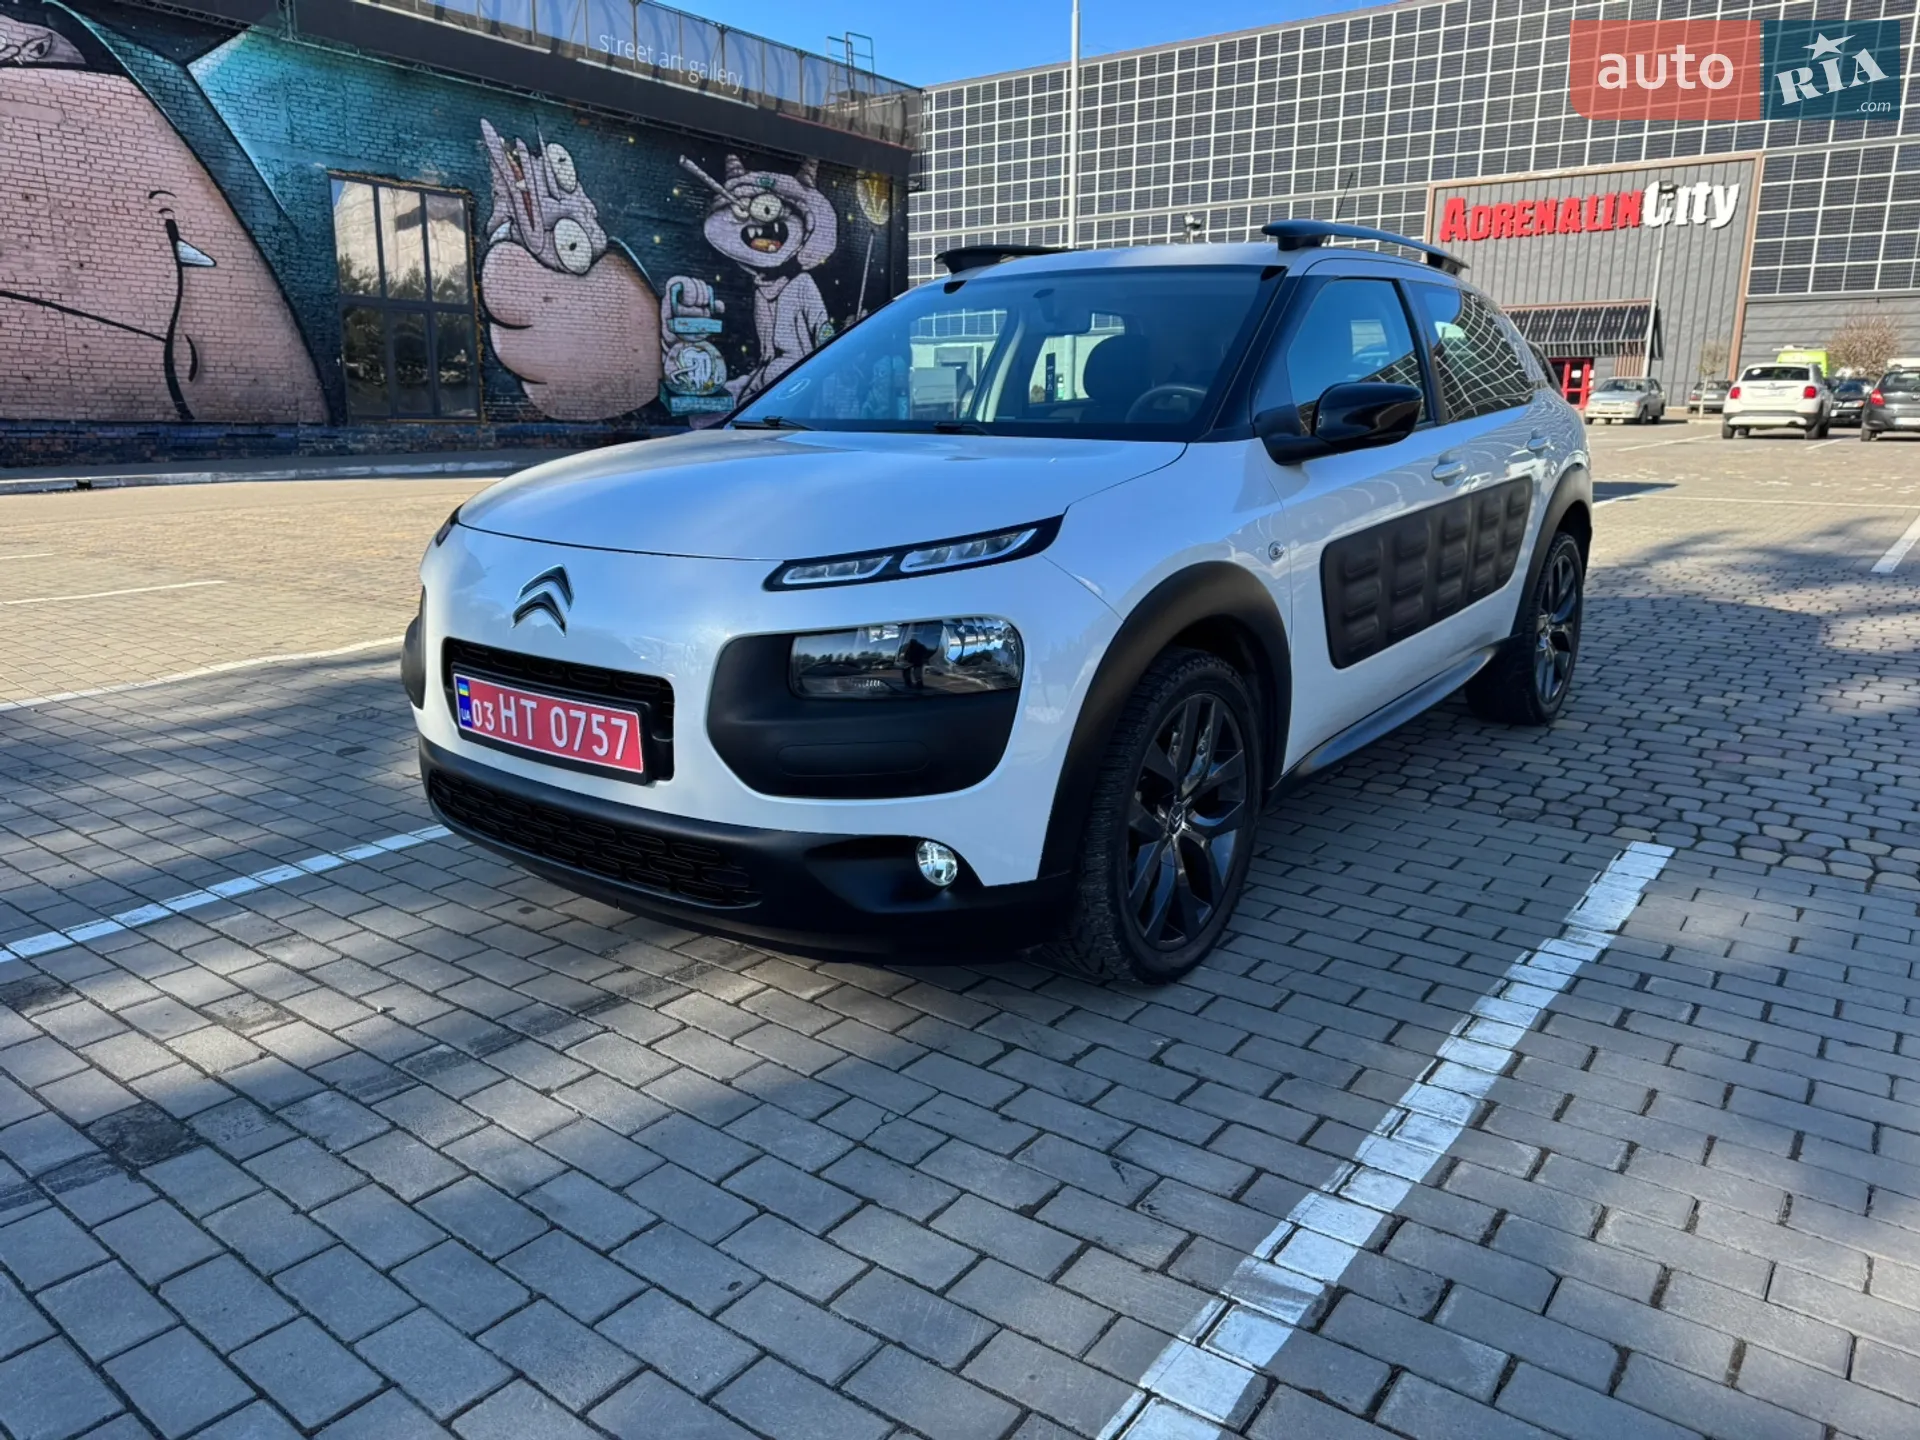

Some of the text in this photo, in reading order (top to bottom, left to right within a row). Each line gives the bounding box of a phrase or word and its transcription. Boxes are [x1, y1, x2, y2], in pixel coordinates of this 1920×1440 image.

[599, 34, 743, 94] street art gallery
[460, 707, 472, 722] UA
[550, 706, 628, 760] 0757
